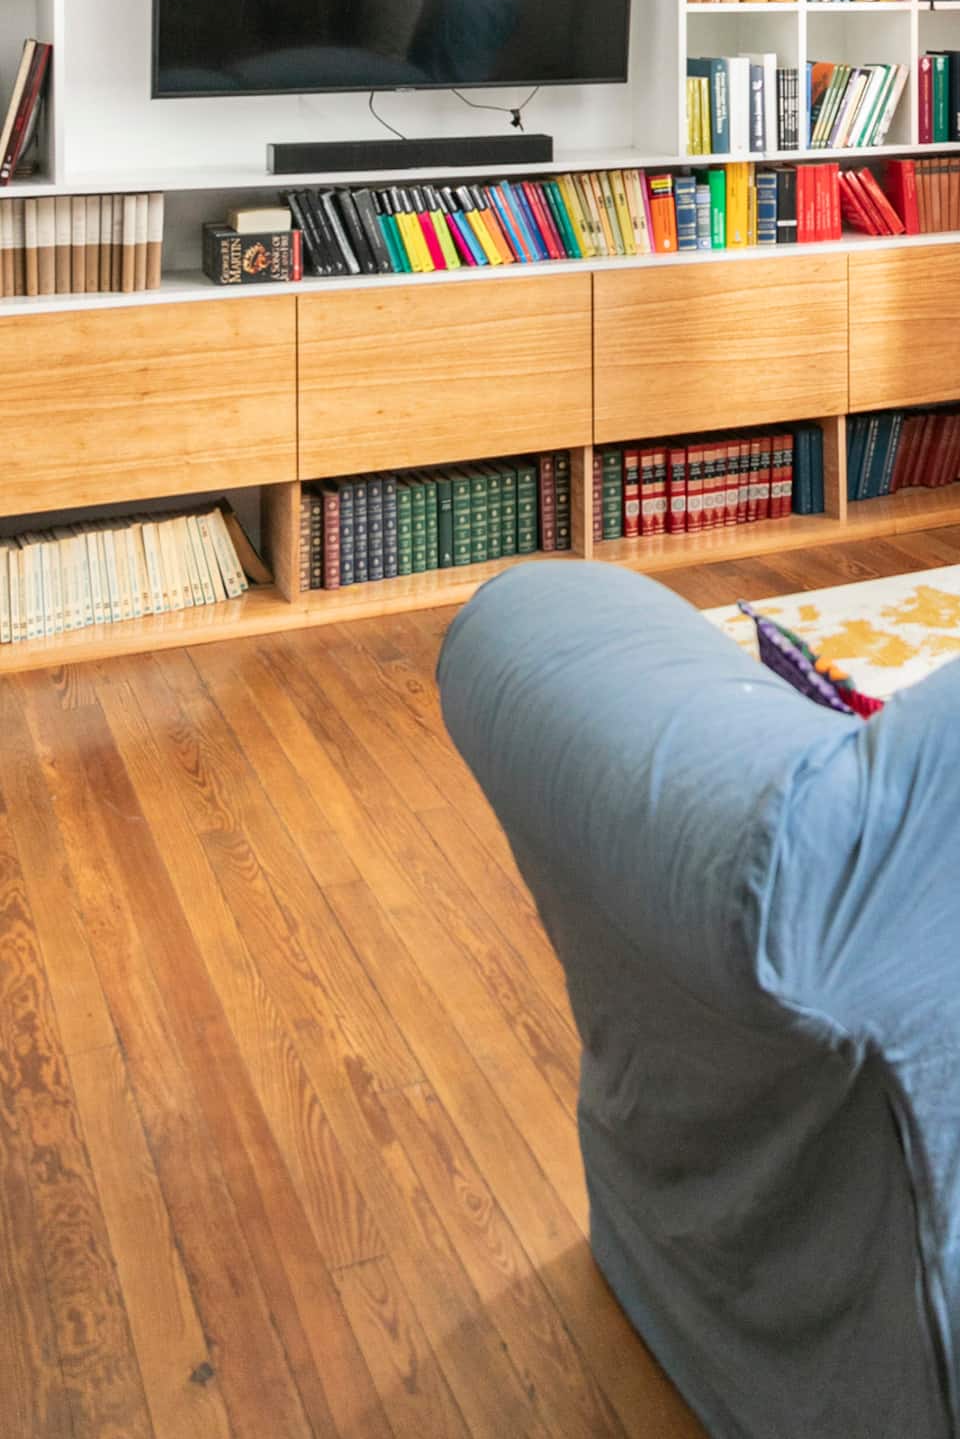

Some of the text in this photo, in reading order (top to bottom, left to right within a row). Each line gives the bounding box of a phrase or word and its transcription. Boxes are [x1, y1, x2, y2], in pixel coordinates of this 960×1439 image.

[271, 236, 280, 247] OF
[229, 238, 241, 283] MARTIN
[271, 247, 280, 273] SONG
